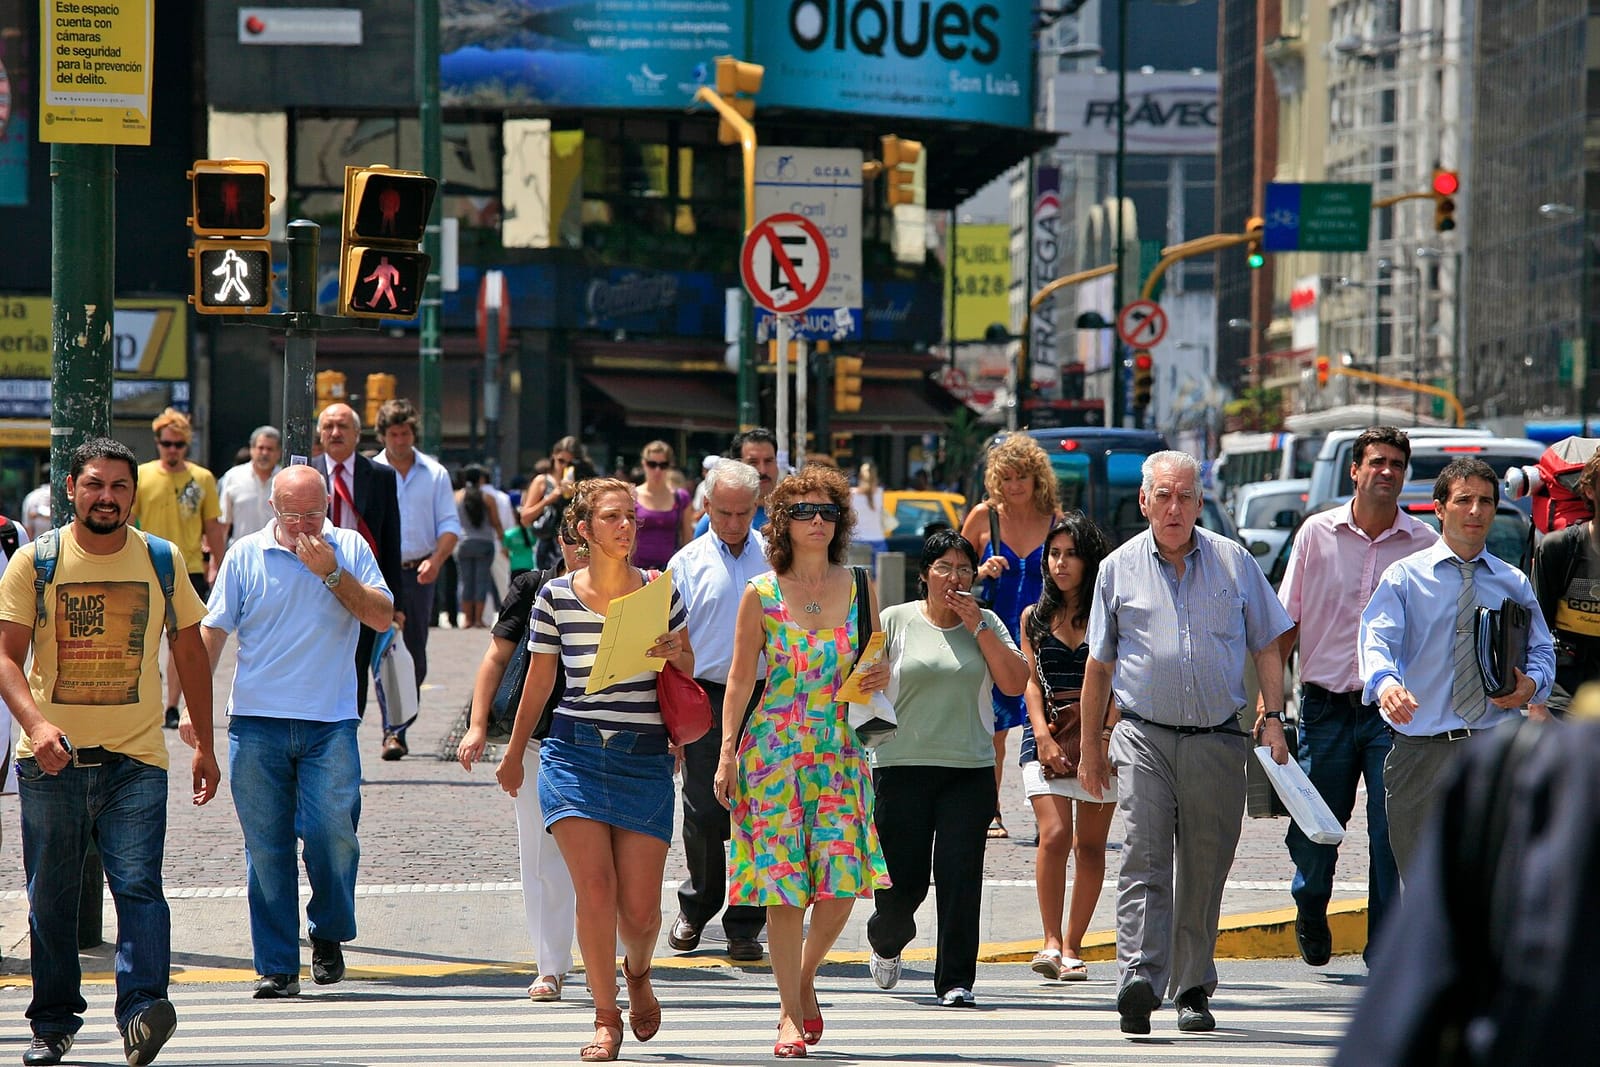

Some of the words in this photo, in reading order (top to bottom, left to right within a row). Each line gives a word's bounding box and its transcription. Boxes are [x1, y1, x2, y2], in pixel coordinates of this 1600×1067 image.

[56, 2, 80, 13] Este
[82, 4, 120, 16] espacio
[56, 18, 91, 28] cuenta
[94, 20, 112, 28] con
[56, 30, 101, 42] cámaras
[56, 45, 70, 55] de
[72, 46, 121, 58] seguridad
[57, 61, 80, 71] para
[83, 60, 92, 70] la
[94, 61, 142, 73] prevención
[56, 73, 72, 83] del
[75, 74, 107, 85] delito.
